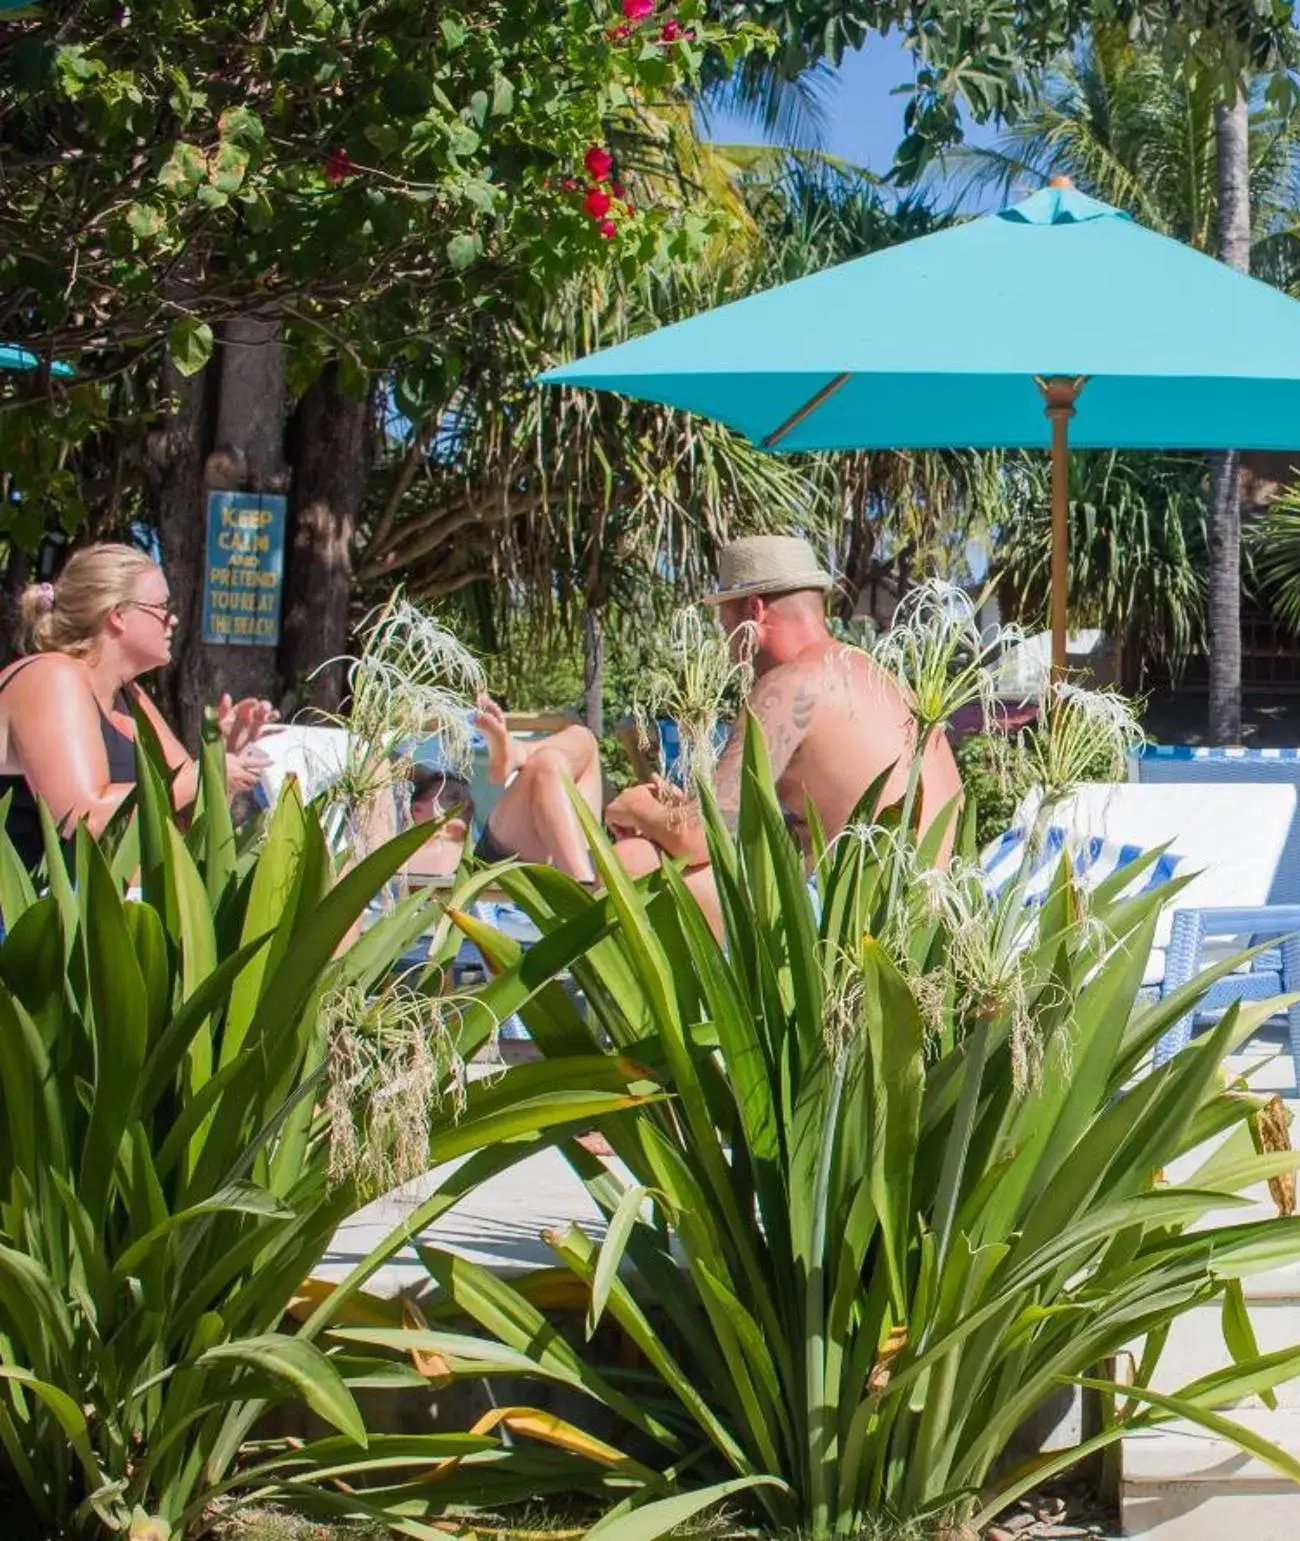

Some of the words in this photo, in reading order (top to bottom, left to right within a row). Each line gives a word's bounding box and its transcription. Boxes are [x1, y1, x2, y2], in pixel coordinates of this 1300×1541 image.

[222, 507, 272, 528] KEEP
[218, 531, 270, 552] CALM
[228, 552, 260, 565] AND
[211, 568, 277, 588] PRETEND
[212, 615, 231, 635] THE
[234, 616, 275, 636] BEACH
